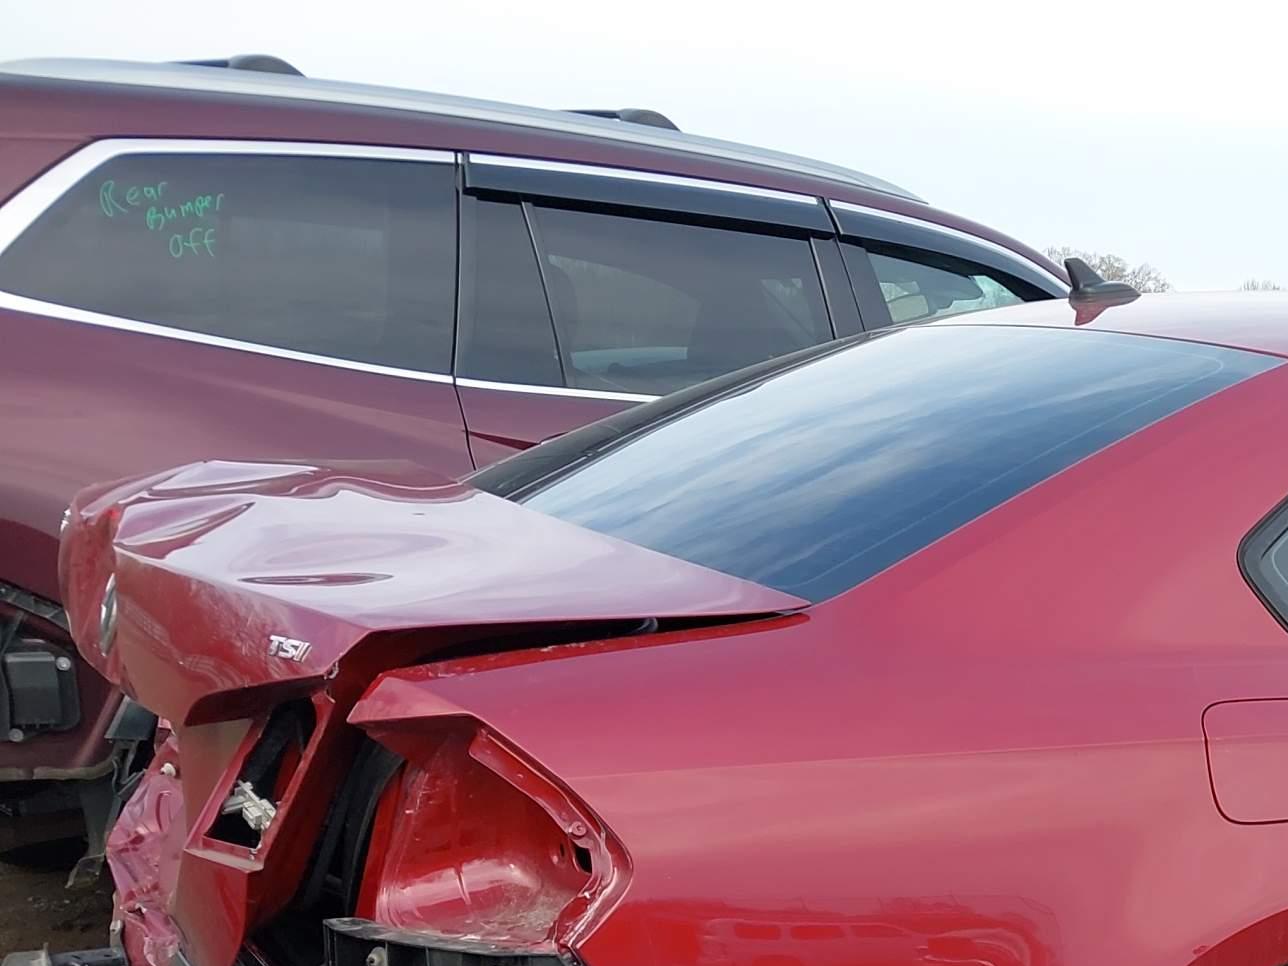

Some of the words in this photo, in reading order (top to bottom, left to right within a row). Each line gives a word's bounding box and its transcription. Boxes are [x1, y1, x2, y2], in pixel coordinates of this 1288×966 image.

[99, 180, 168, 217] Rear
[146, 193, 225, 231] Bumper
[269, 634, 312, 663] TSI
